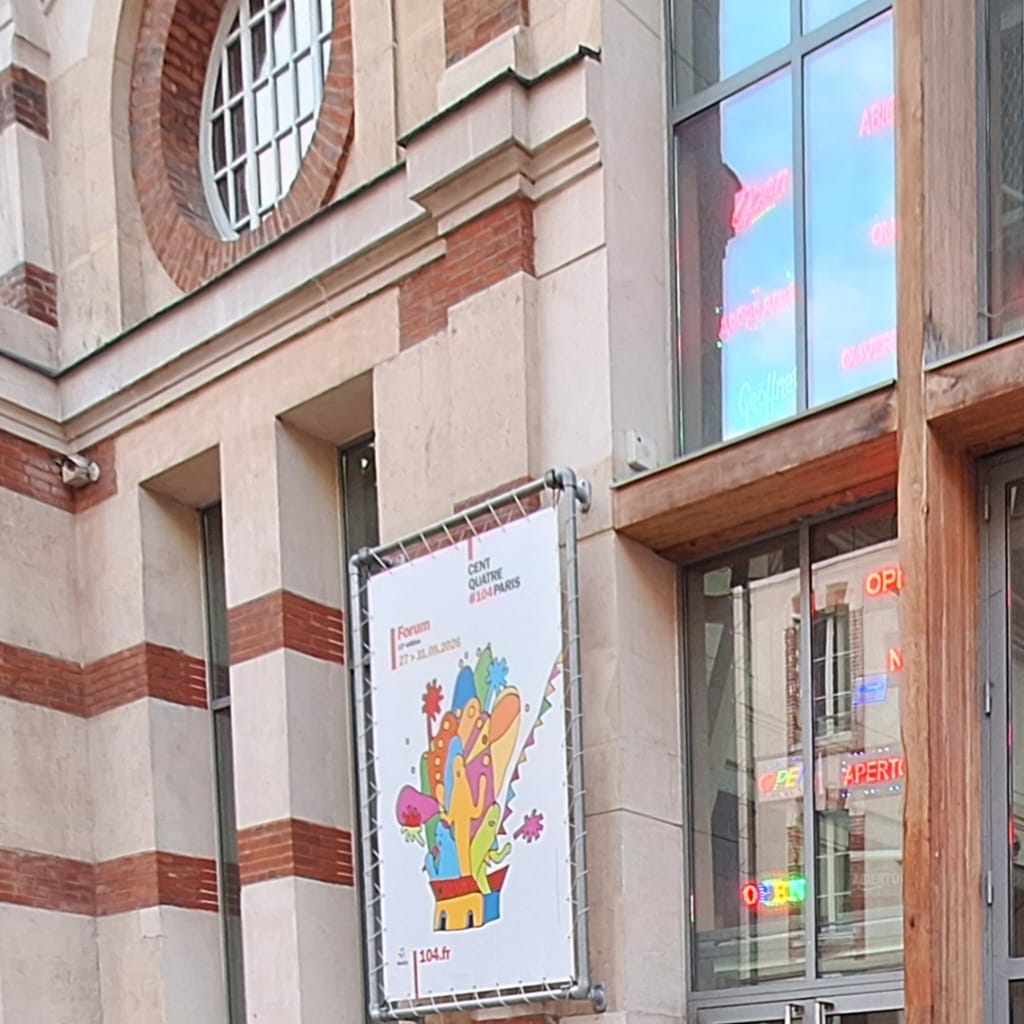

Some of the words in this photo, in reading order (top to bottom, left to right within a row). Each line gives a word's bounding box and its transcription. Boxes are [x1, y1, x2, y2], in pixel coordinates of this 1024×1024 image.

[468, 556, 491, 576] CENT
[468, 566, 503, 591] QUATRE
[398, 620, 431, 641] Forum
[419, 945, 451, 964] 104.fr
